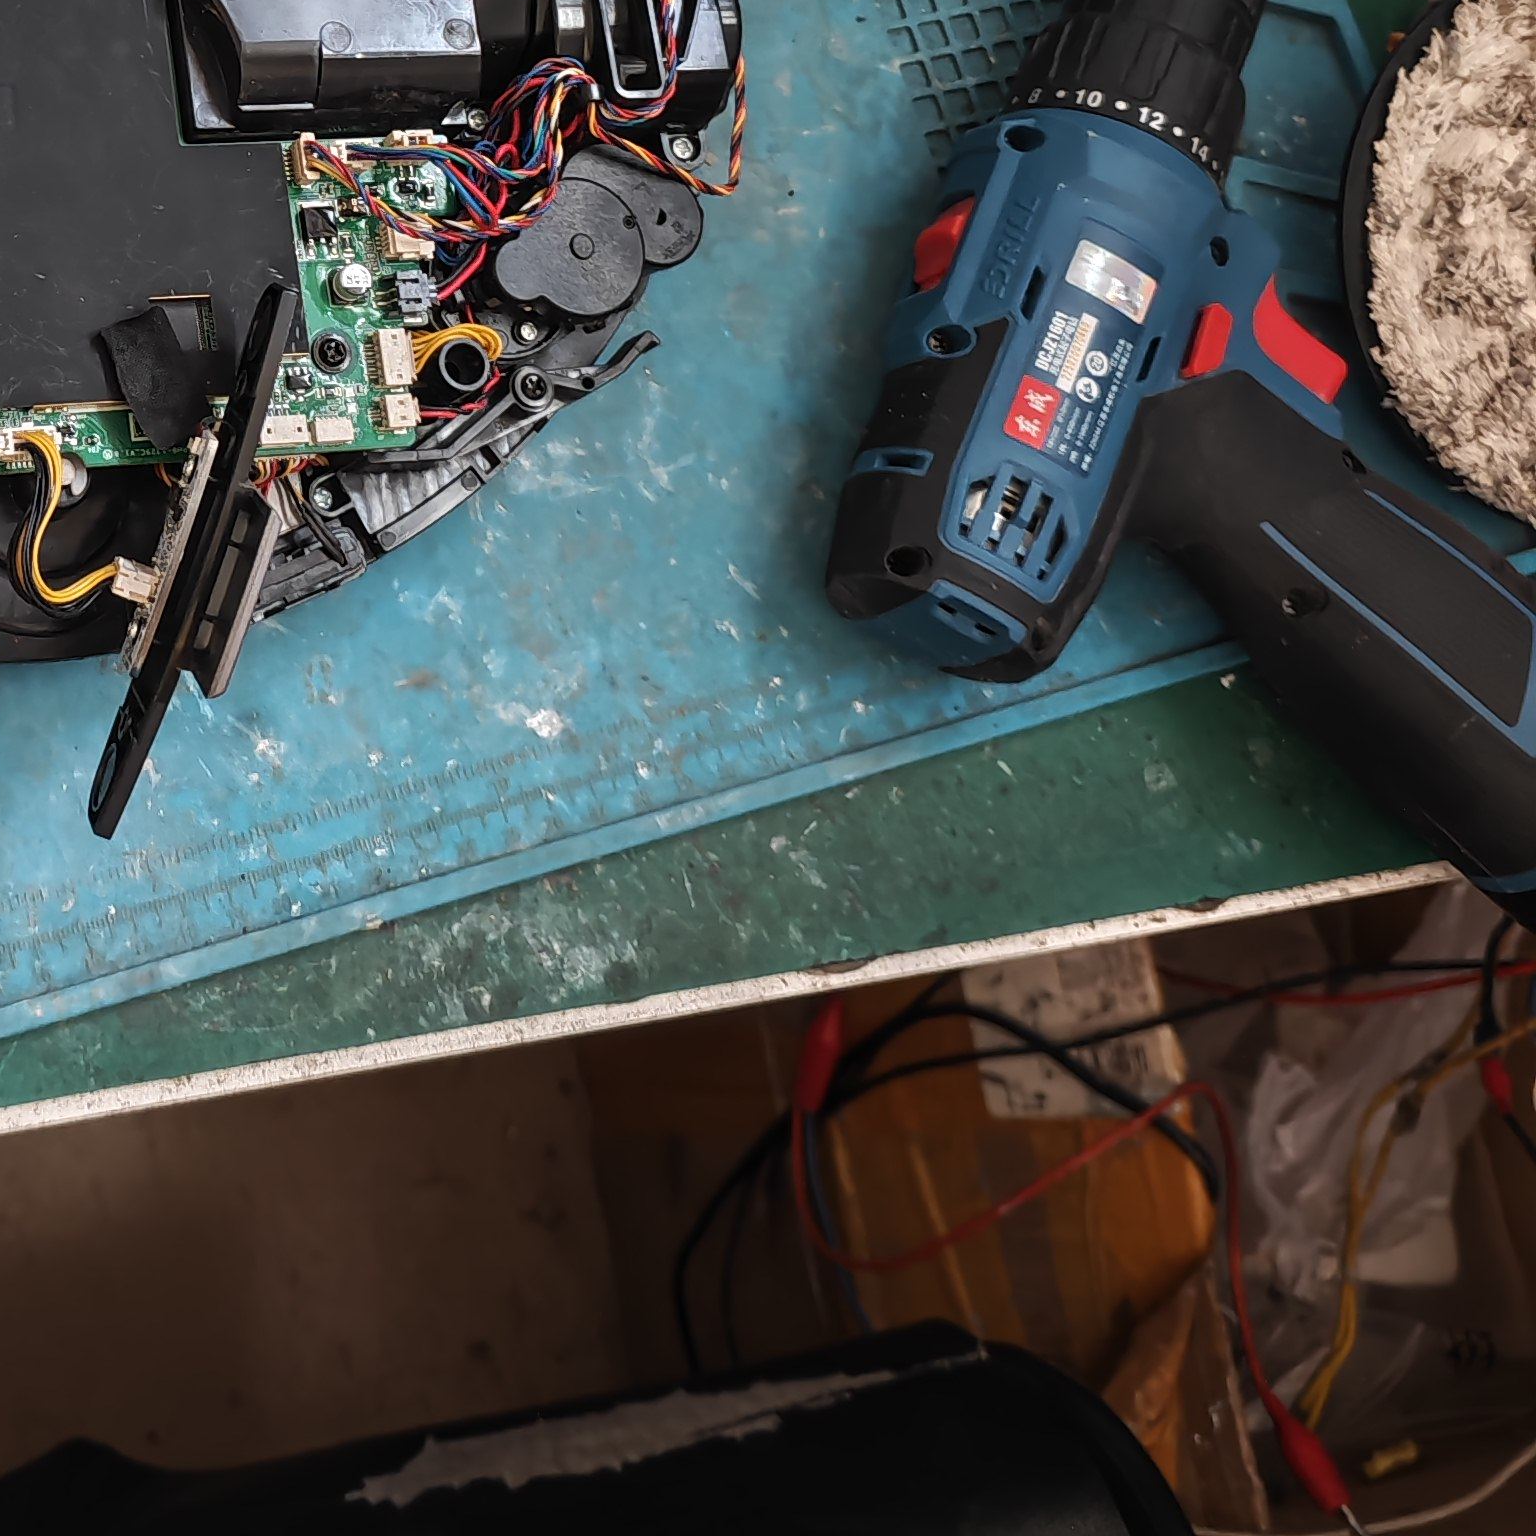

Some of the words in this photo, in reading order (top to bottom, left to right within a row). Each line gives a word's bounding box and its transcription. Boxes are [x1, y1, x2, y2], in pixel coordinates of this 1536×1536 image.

[1027, 87, 1043, 104] 8
[1075, 88, 1104, 108] 10
[1138, 106, 1167, 131] 12
[1191, 136, 1211, 162] 14
[1014, 388, 1056, 439] 东成
